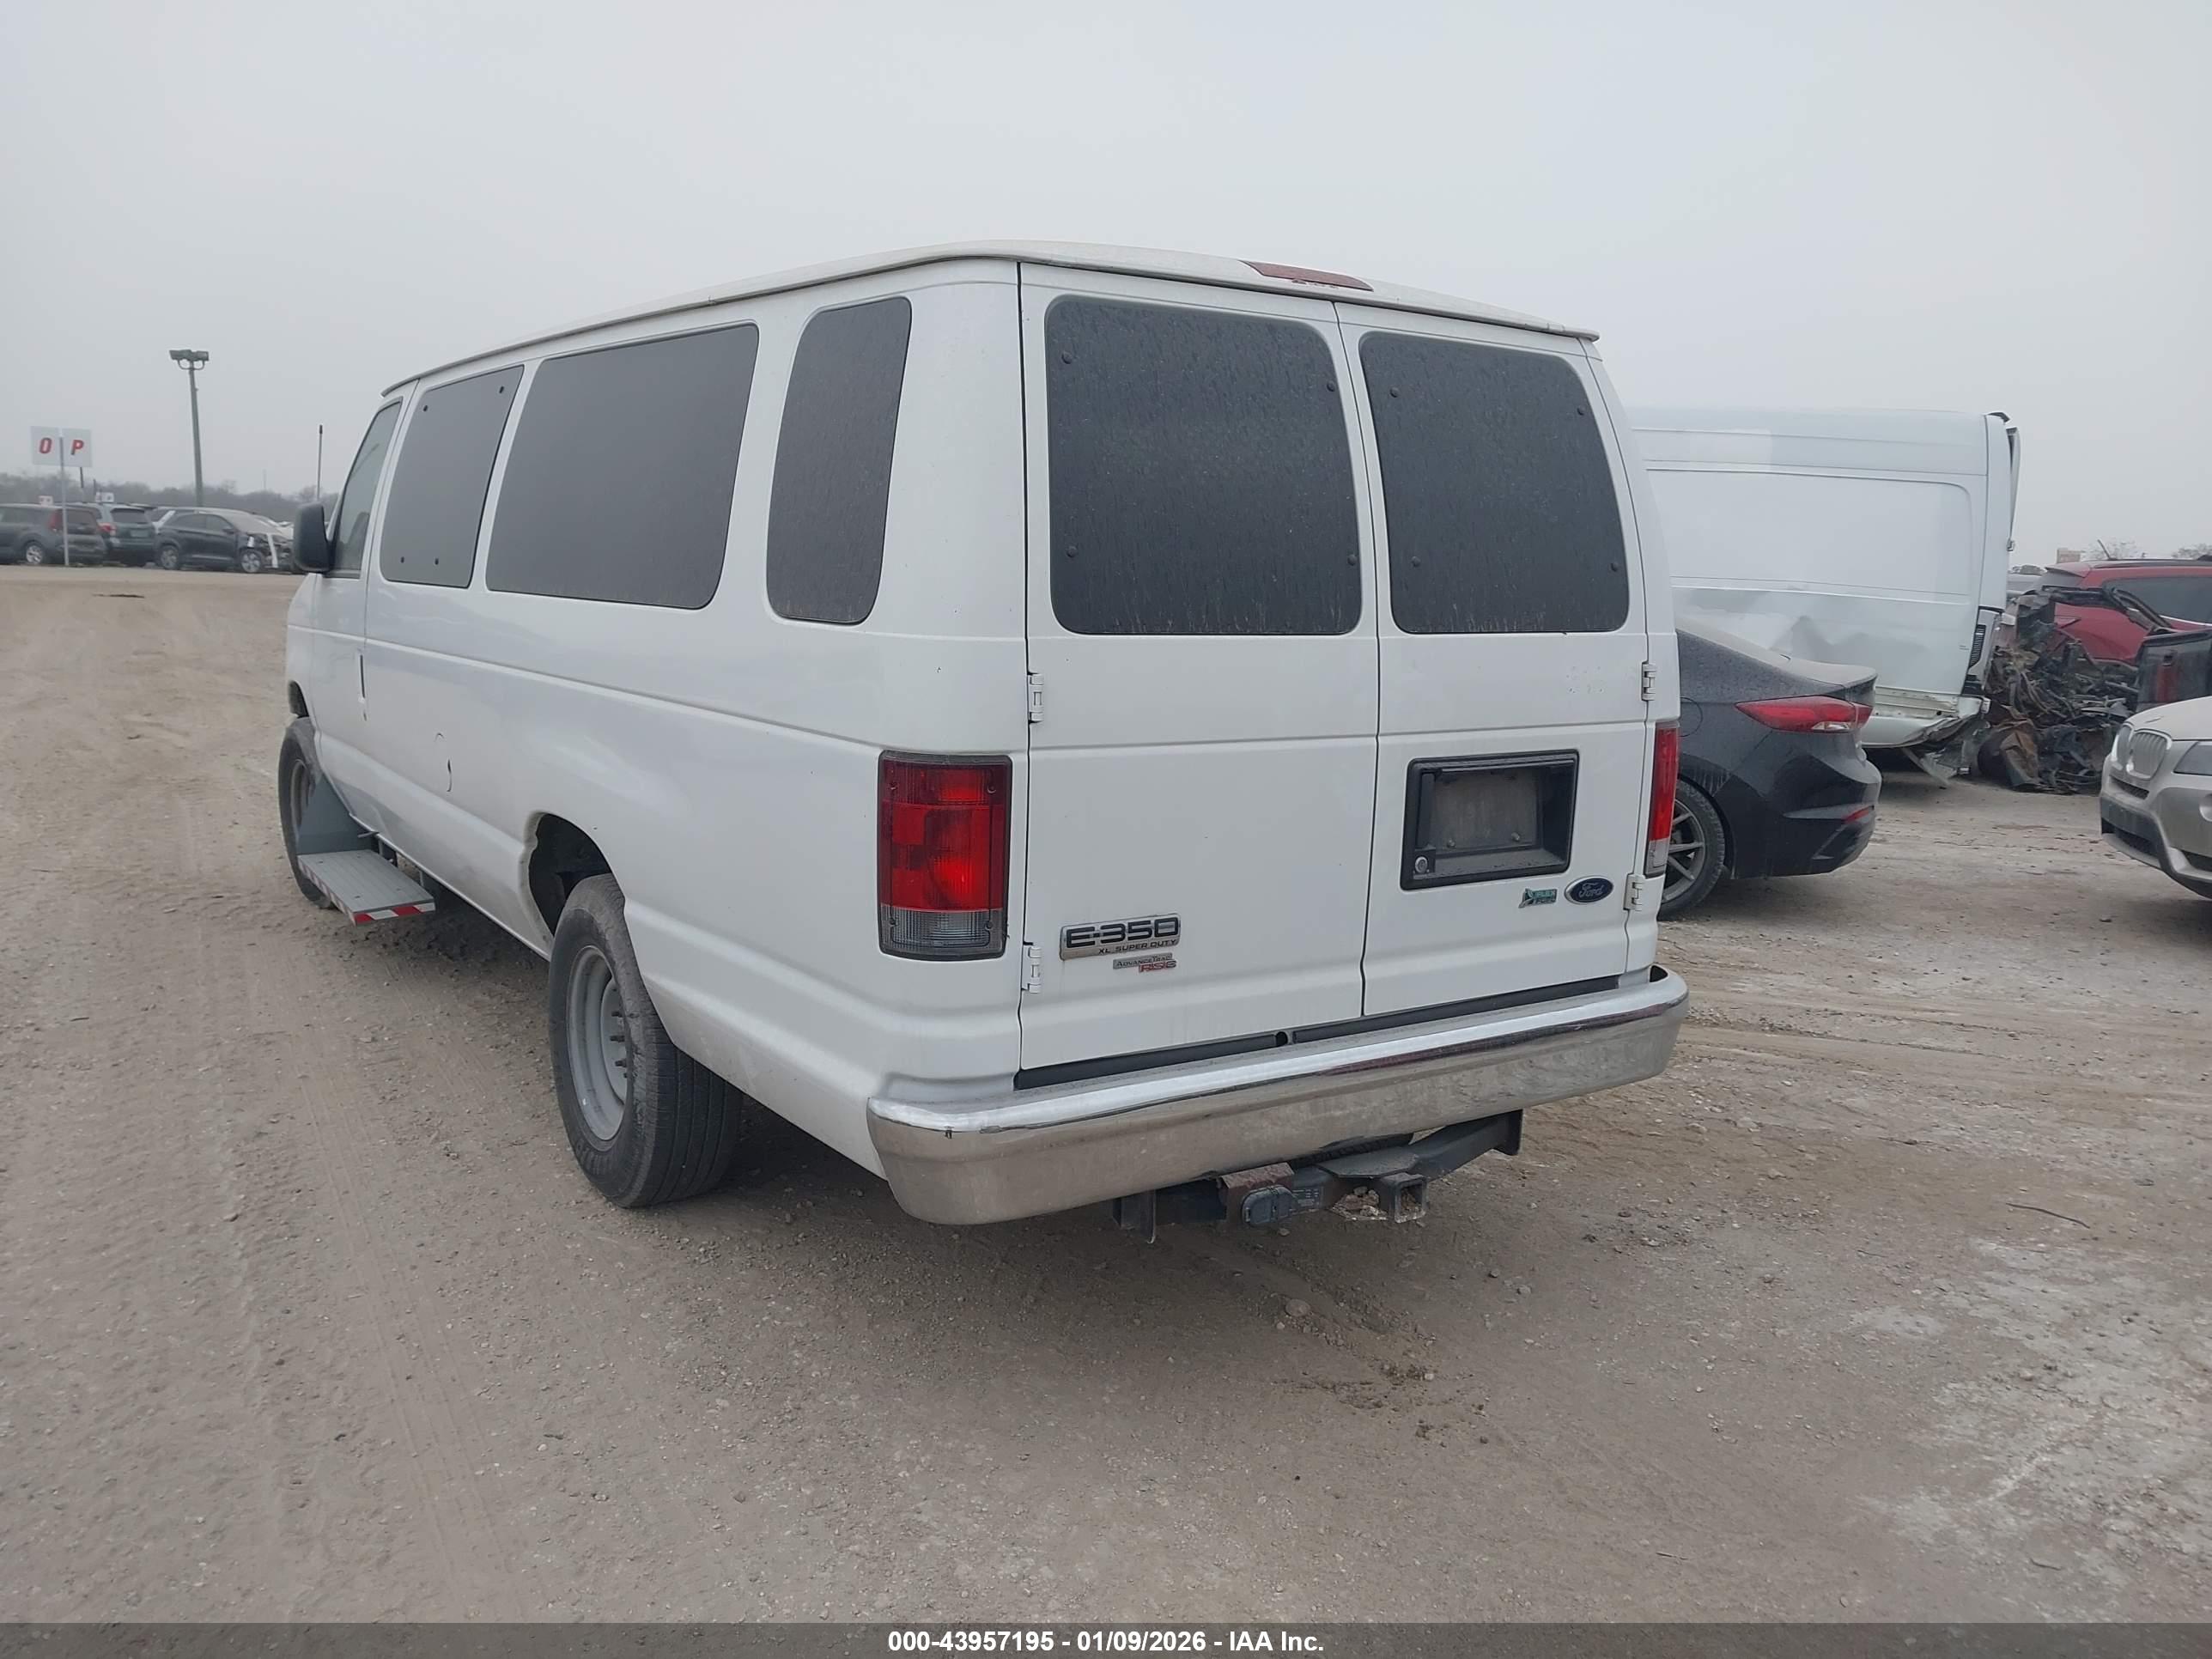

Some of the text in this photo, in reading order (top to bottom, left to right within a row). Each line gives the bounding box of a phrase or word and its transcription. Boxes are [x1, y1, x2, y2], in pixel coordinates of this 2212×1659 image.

[70, 439, 84, 455] P
[1579, 882, 1605, 898] Ford
[1066, 917, 1179, 949] E-350
[1116, 942, 1149, 952] SUPER
[1150, 939, 1177, 948] DUTY
